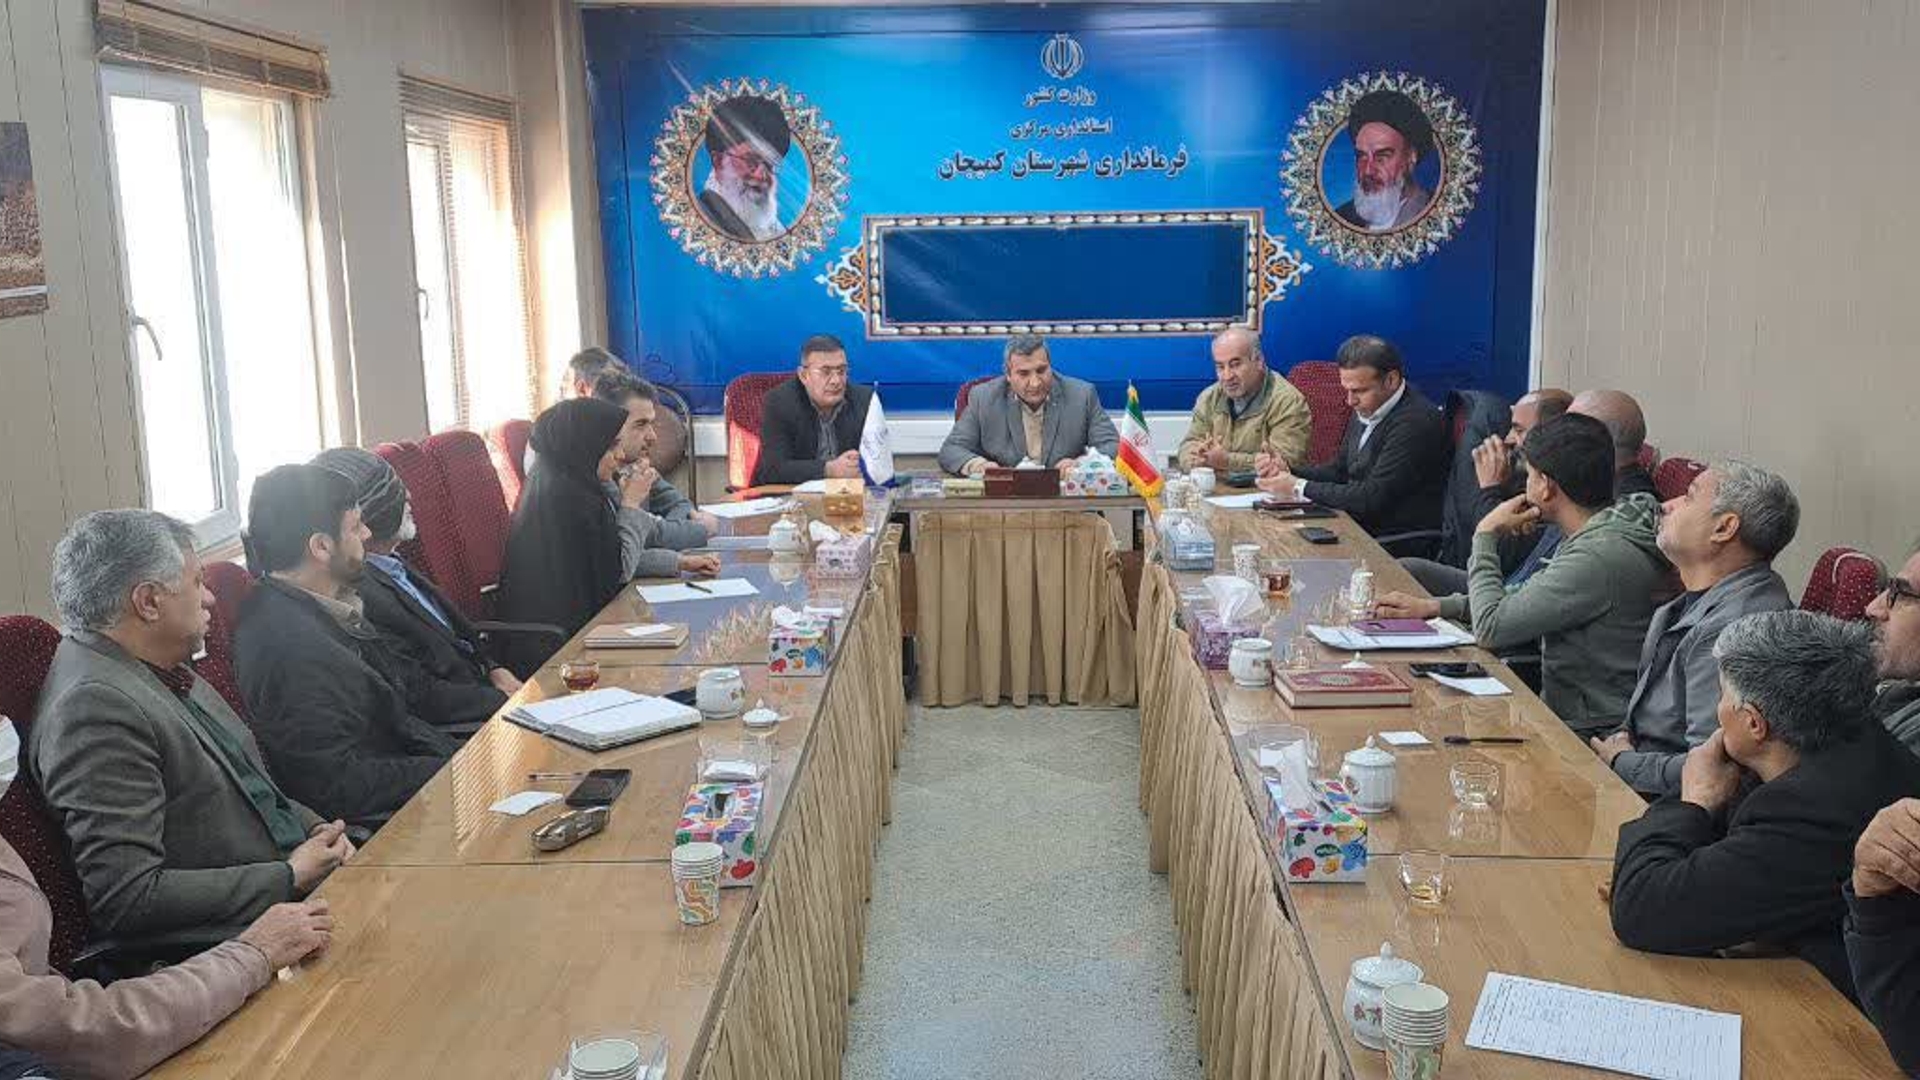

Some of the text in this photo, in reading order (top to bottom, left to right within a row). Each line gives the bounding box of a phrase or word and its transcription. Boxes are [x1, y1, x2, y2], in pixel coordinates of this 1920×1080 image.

[1022, 85, 1097, 107] وزارت کشور
[1009, 116, 1113, 139] استانداری مرکزی
[937, 143, 1188, 179] فرمانداری شهرستان کمیجان
